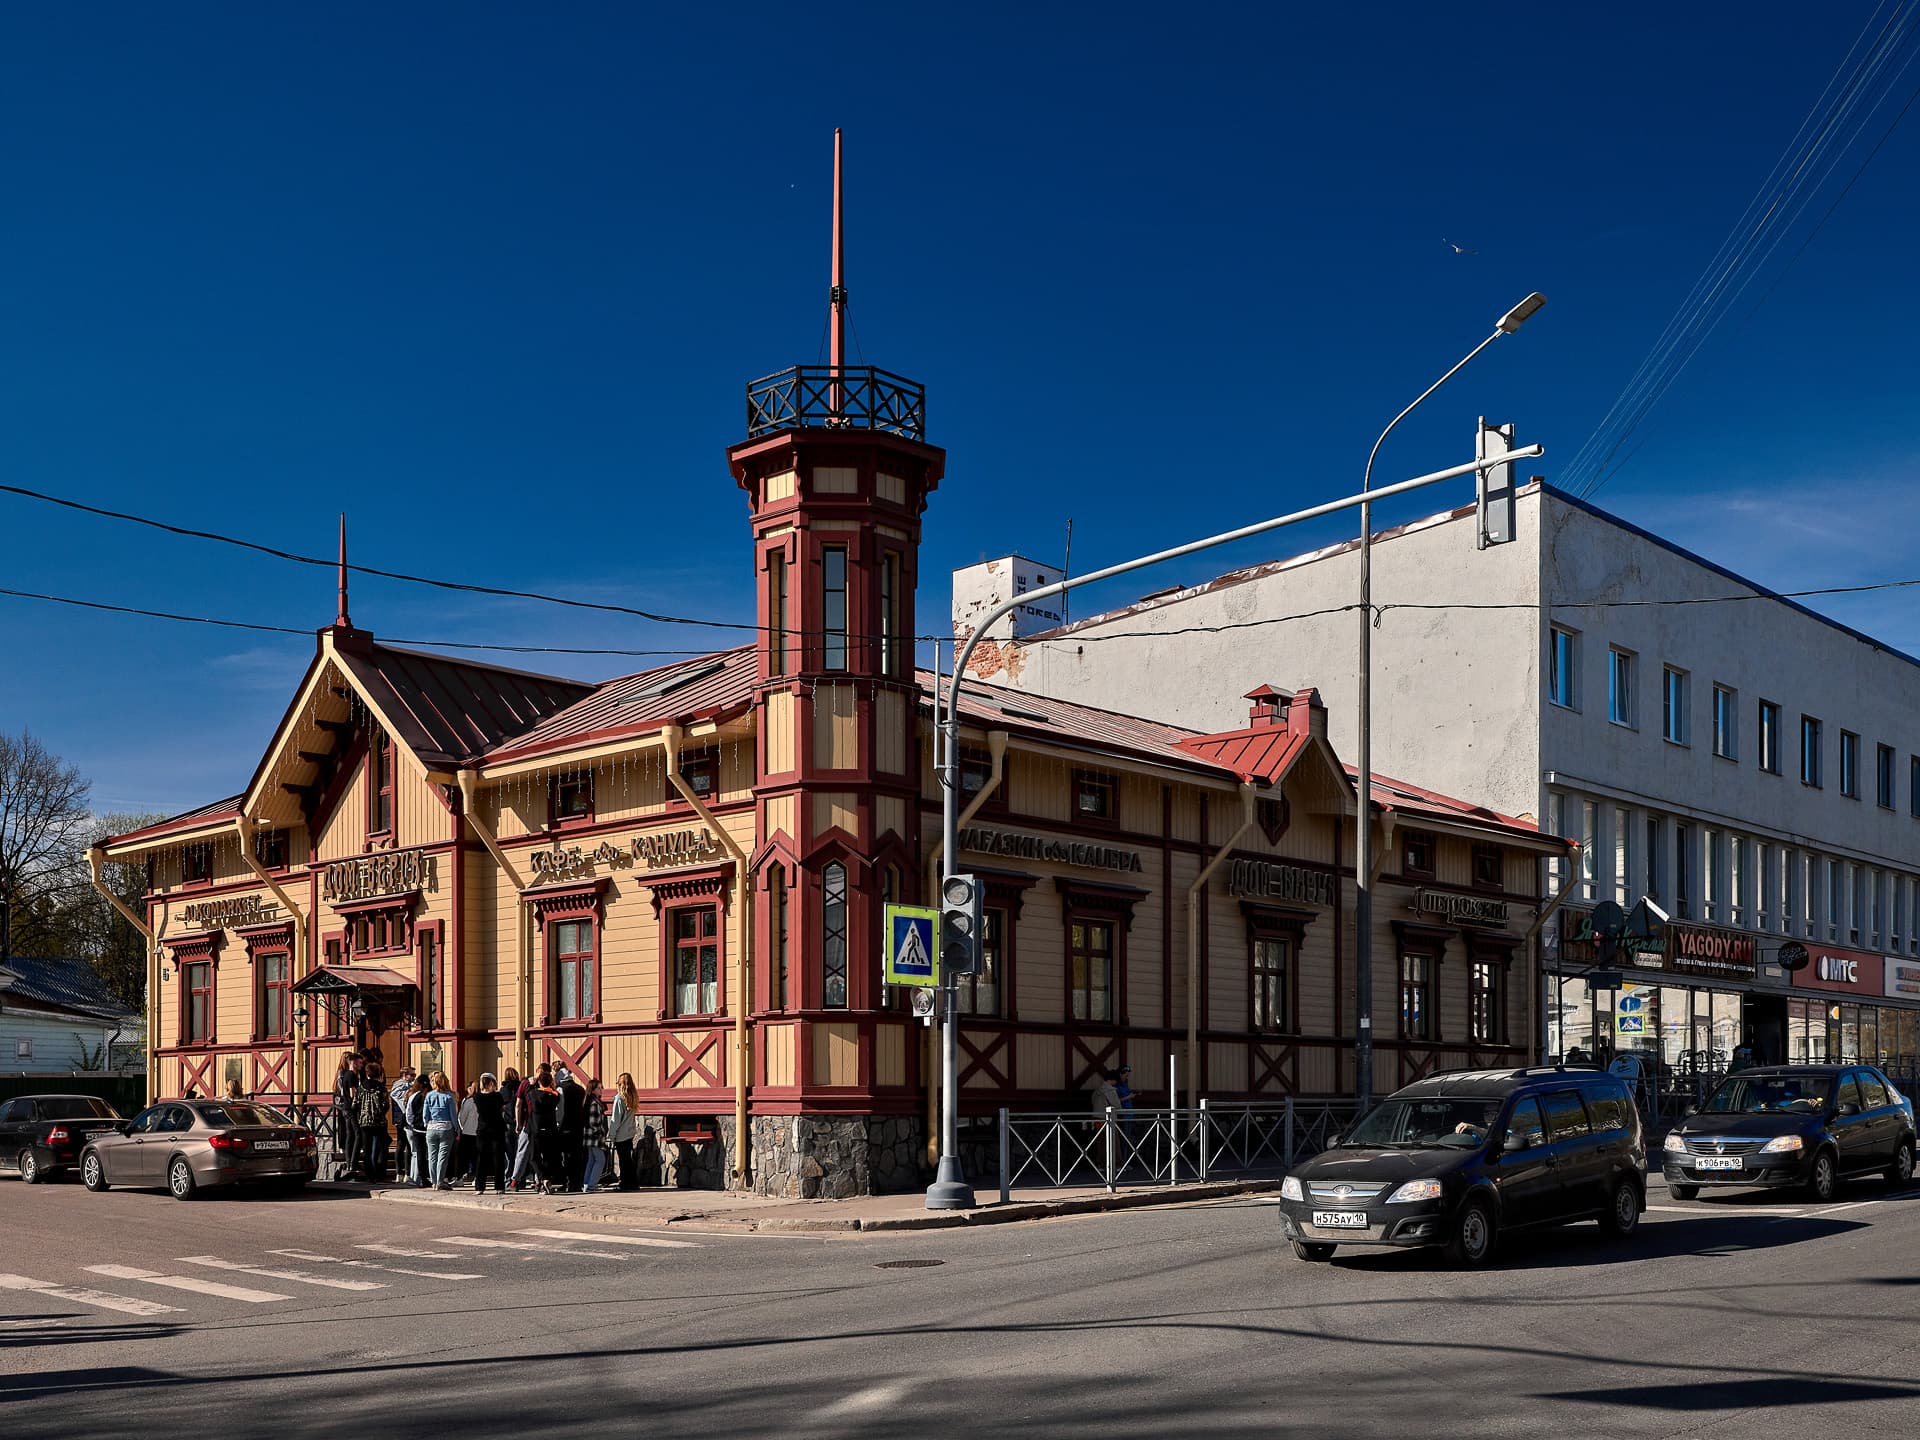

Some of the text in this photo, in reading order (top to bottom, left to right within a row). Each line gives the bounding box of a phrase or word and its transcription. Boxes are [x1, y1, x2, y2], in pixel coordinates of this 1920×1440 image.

[630, 828, 713, 860] KAHVILA
[530, 847, 581, 873] КАФЕ
[323, 861, 360, 901] ДОМ
[184, 895, 262, 922] ALKOMARKET
[1679, 932, 1752, 960] YAGODY.RU
[1829, 958, 1857, 982] МТС
[1698, 1158, 1729, 1167] К906РВ
[1316, 1213, 1364, 1224] Н575АУ 10
